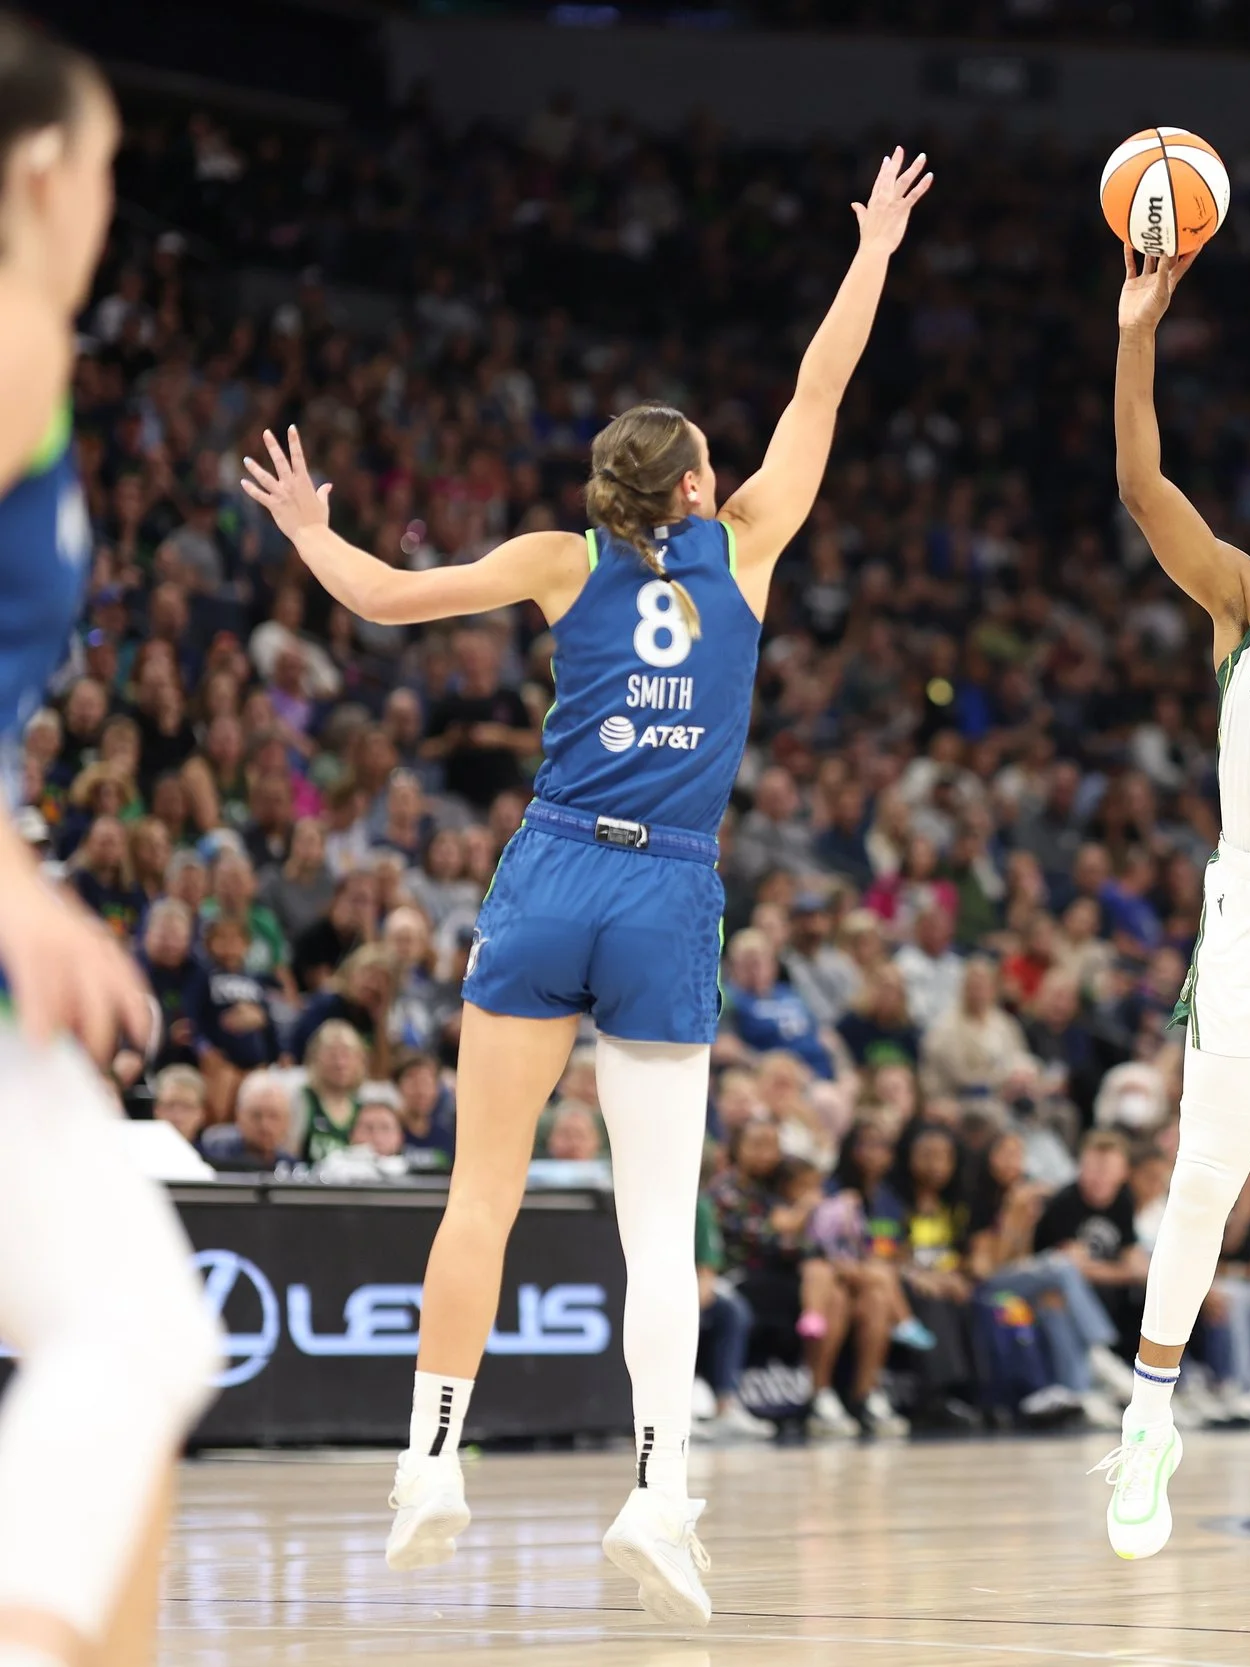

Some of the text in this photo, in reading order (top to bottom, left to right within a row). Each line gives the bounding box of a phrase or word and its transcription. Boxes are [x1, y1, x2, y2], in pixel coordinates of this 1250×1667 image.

[633, 578, 692, 668] 8
[626, 674, 693, 710] SMITH
[637, 726, 705, 750] AT&T
[287, 1283, 612, 1356] LEUS
